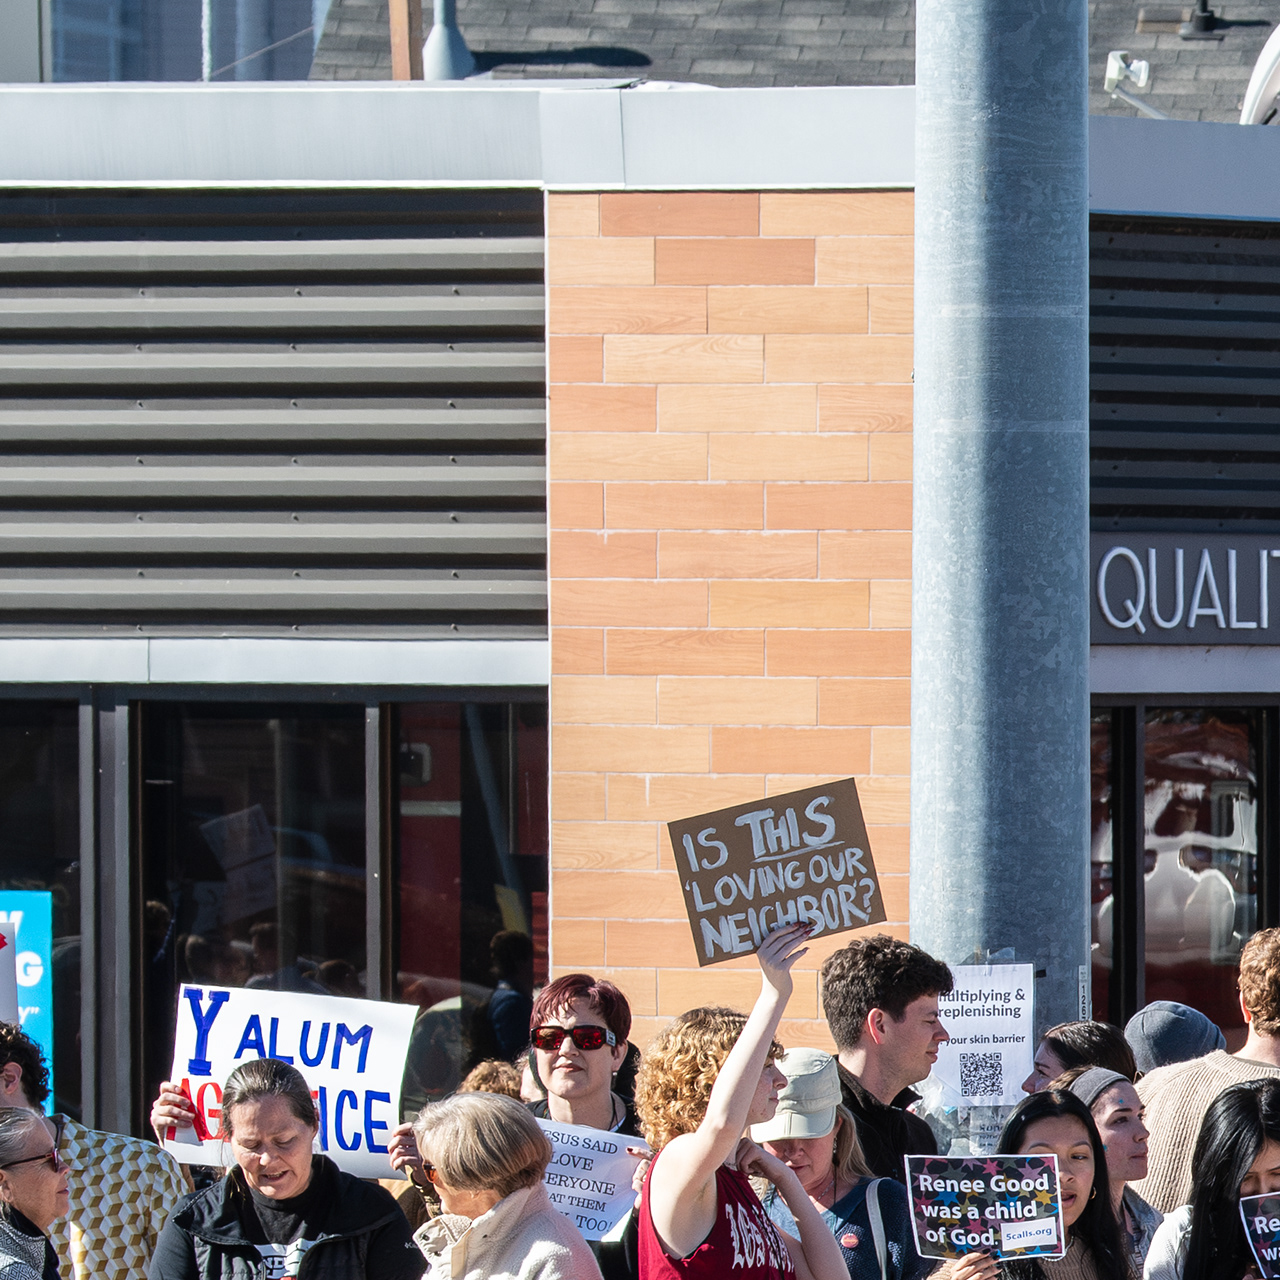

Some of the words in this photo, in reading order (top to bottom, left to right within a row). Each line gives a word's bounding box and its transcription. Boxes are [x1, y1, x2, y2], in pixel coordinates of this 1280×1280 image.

[682, 827, 729, 872] IS
[734, 796, 836, 858] THIS
[808, 847, 868, 884] OUR
[1015, 988, 1025, 1001] &
[938, 1004, 1021, 1019] replenishing
[183, 986, 230, 1076] Y
[234, 1014, 373, 1073] ALUM
[969, 1034, 990, 1045] skin
[992, 1034, 1025, 1043] barrier
[319, 1086, 392, 1153] ICE
[581, 1137, 618, 1155] SAID
[919, 1174, 985, 1192] Renee
[990, 1173, 1049, 1192] Good
[567, 1195, 607, 1212] THEM
[921, 1204, 962, 1219] was
[967, 1208, 980, 1220] a
[984, 1200, 1037, 1219] child
[576, 1214, 612, 1232] TOO!
[925, 1227, 946, 1244] of
[950, 1228, 999, 1246] God.
[1006, 1226, 1052, 1241] 5calls.org
